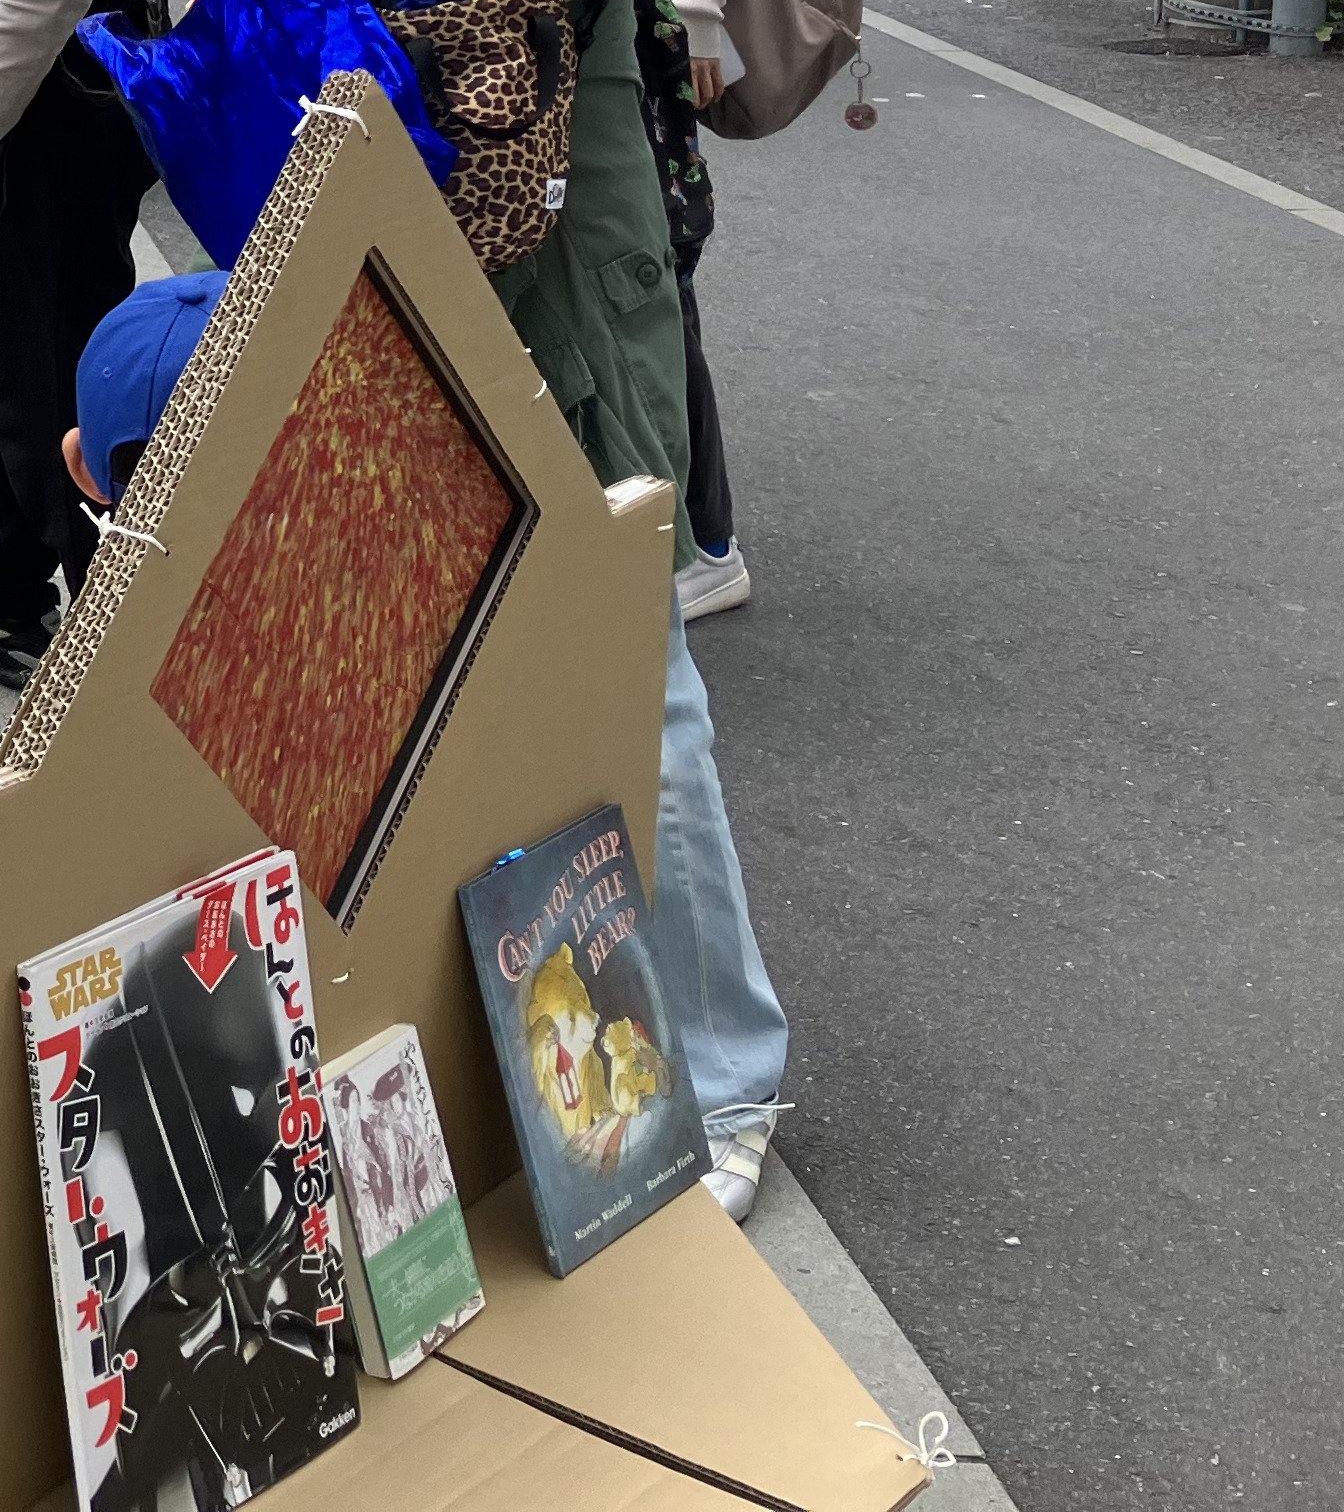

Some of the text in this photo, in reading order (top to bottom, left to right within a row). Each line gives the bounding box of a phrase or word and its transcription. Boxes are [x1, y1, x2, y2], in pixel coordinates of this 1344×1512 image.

[543, 871, 576, 929] YOU
[570, 870, 628, 946] LITTLE
[48, 945, 122, 993] STAR
[586, 906, 639, 977] BEAR?
[49, 967, 123, 1022] WARS
[243, 863, 346, 1327] ほんとのおおきさ
[645, 1149, 696, 1193] Barbara Firth
[37, 1025, 138, 1449] スター・ウォーズ
[574, 1193, 634, 1242] Martin Waddell
[318, 1406, 356, 1438] Gakken
